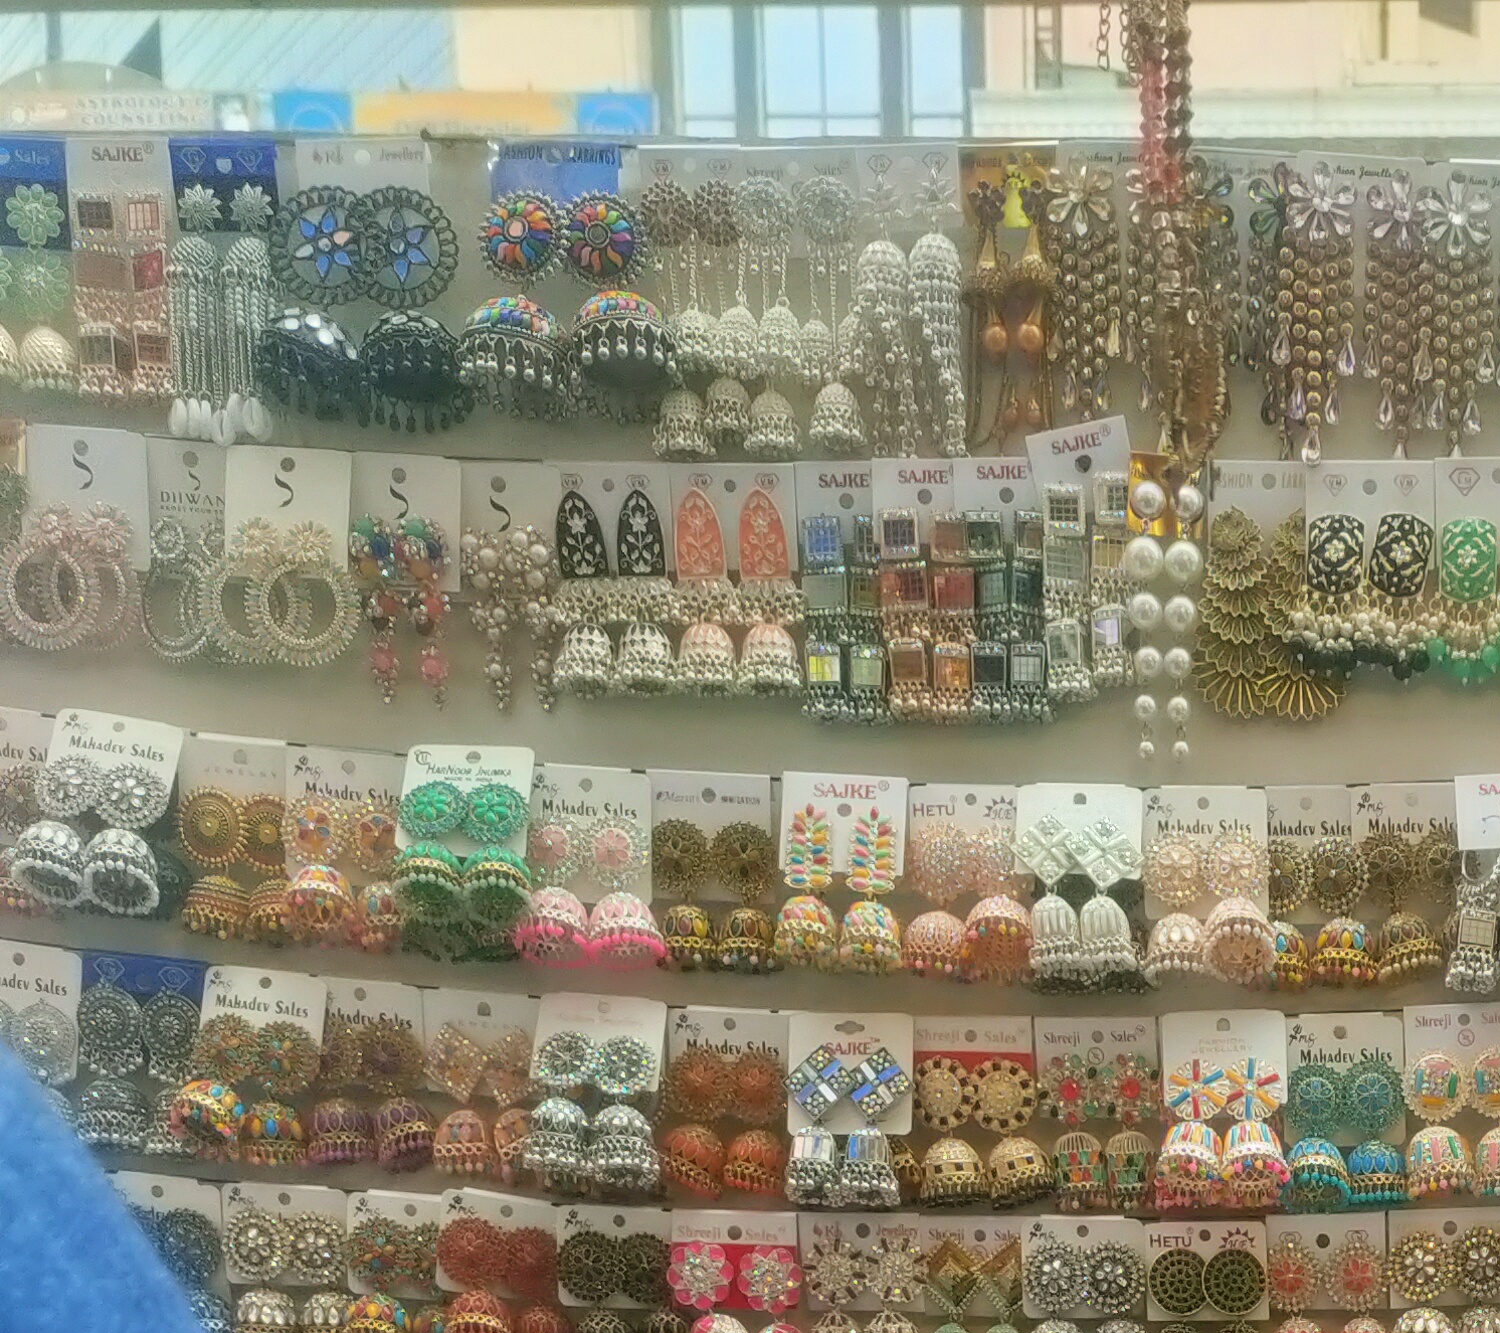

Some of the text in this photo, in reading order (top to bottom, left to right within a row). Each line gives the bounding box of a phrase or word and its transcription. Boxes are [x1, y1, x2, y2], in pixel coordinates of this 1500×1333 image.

[69, 735, 165, 762] Mahadev Sales
[542, 799, 637, 820] Mahadev Sales
[913, 802, 956, 818] HETU
[1158, 819, 1213, 836] Mahadev
[1369, 817, 1424, 835] Mahadev
[34, 978, 68, 997] Sales
[215, 993, 309, 1019] Mahadev Sales
[1043, 1029, 1137, 1047] Shreeji Sales
[1300, 1046, 1392, 1065] Mahadev Sales
[1150, 1233, 1192, 1248] HETU
